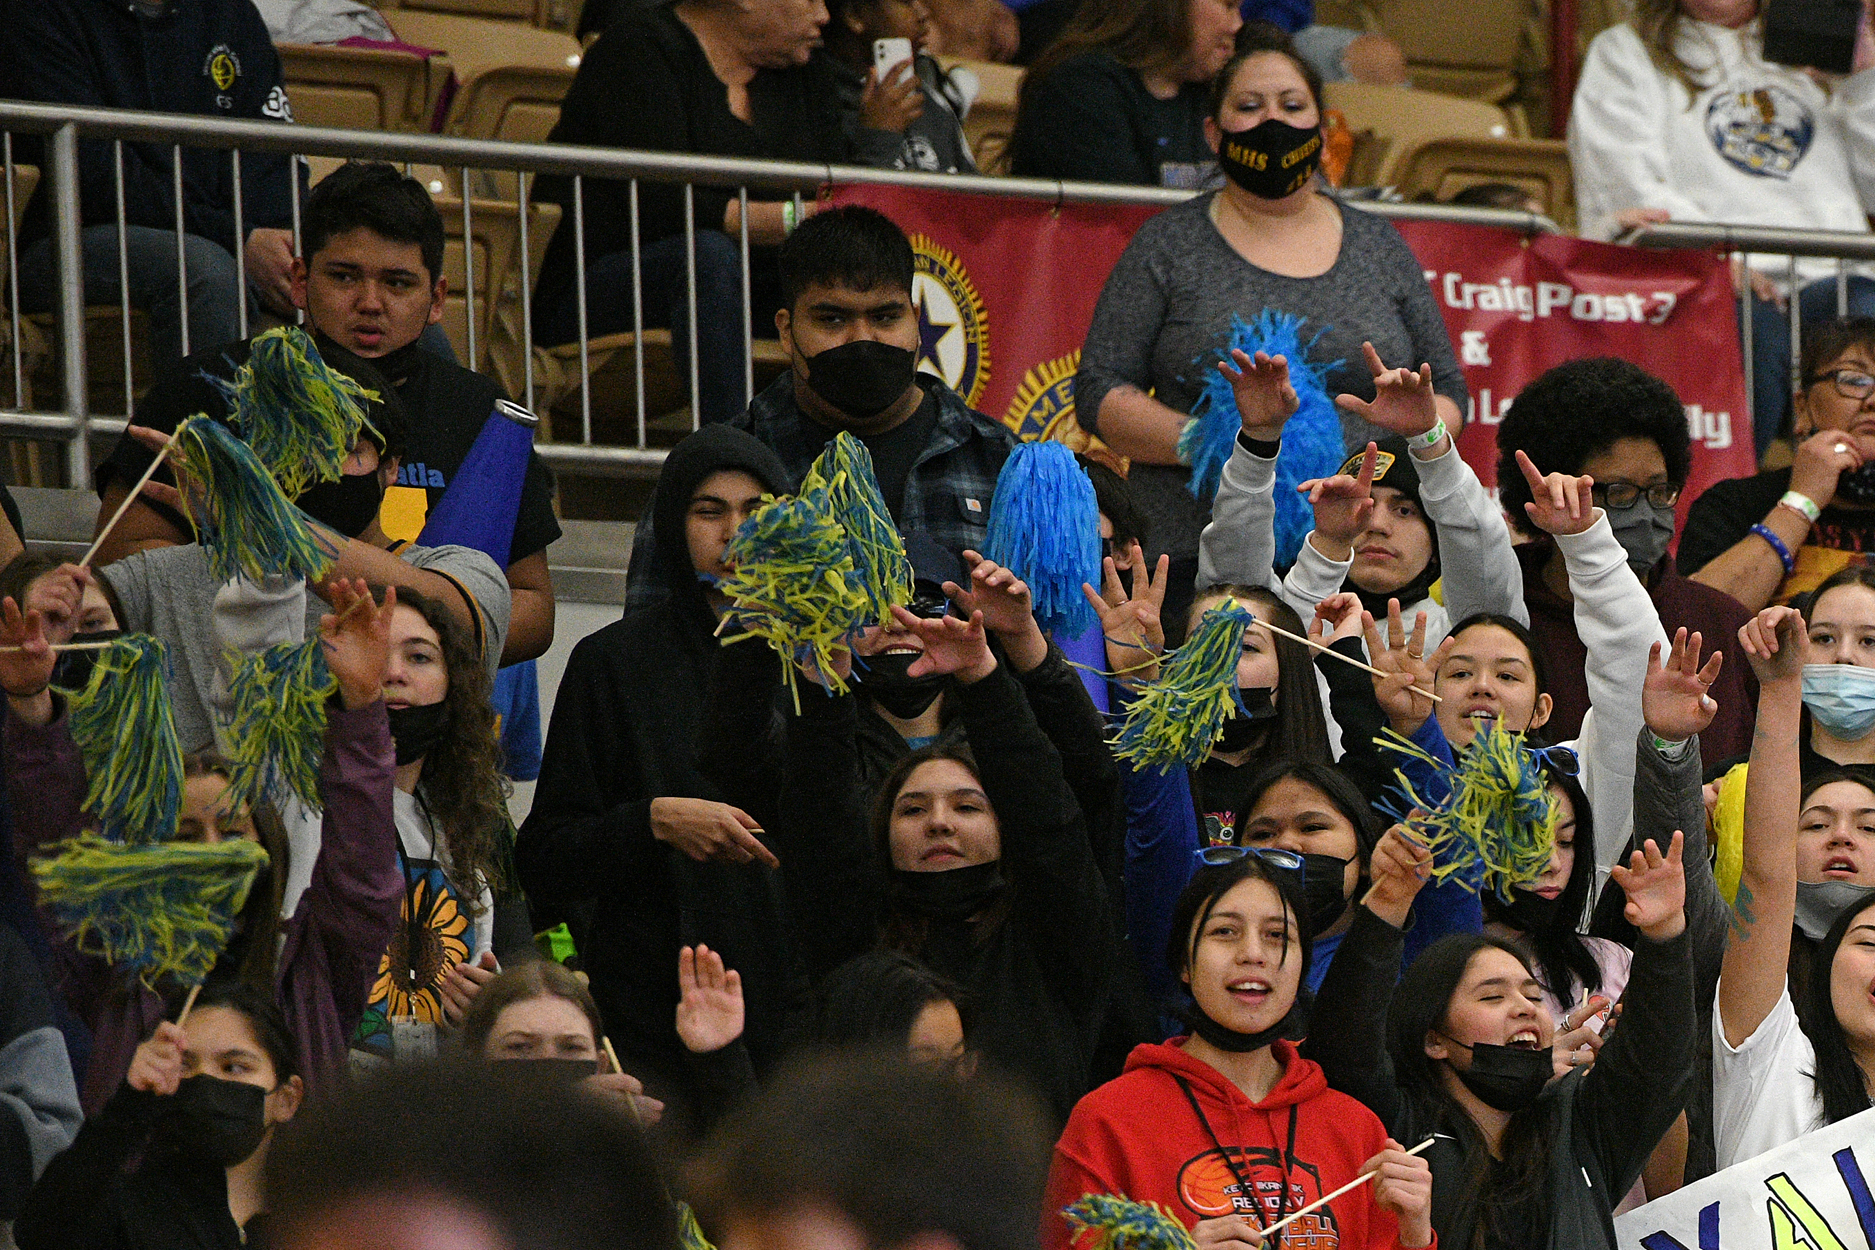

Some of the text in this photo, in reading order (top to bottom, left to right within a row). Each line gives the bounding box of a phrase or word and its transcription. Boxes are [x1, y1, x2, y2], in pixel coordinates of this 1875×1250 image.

[1226, 142, 1269, 172] MHS
[1443, 271, 1678, 325] Craig Post 3
[1460, 331, 1492, 366] &
